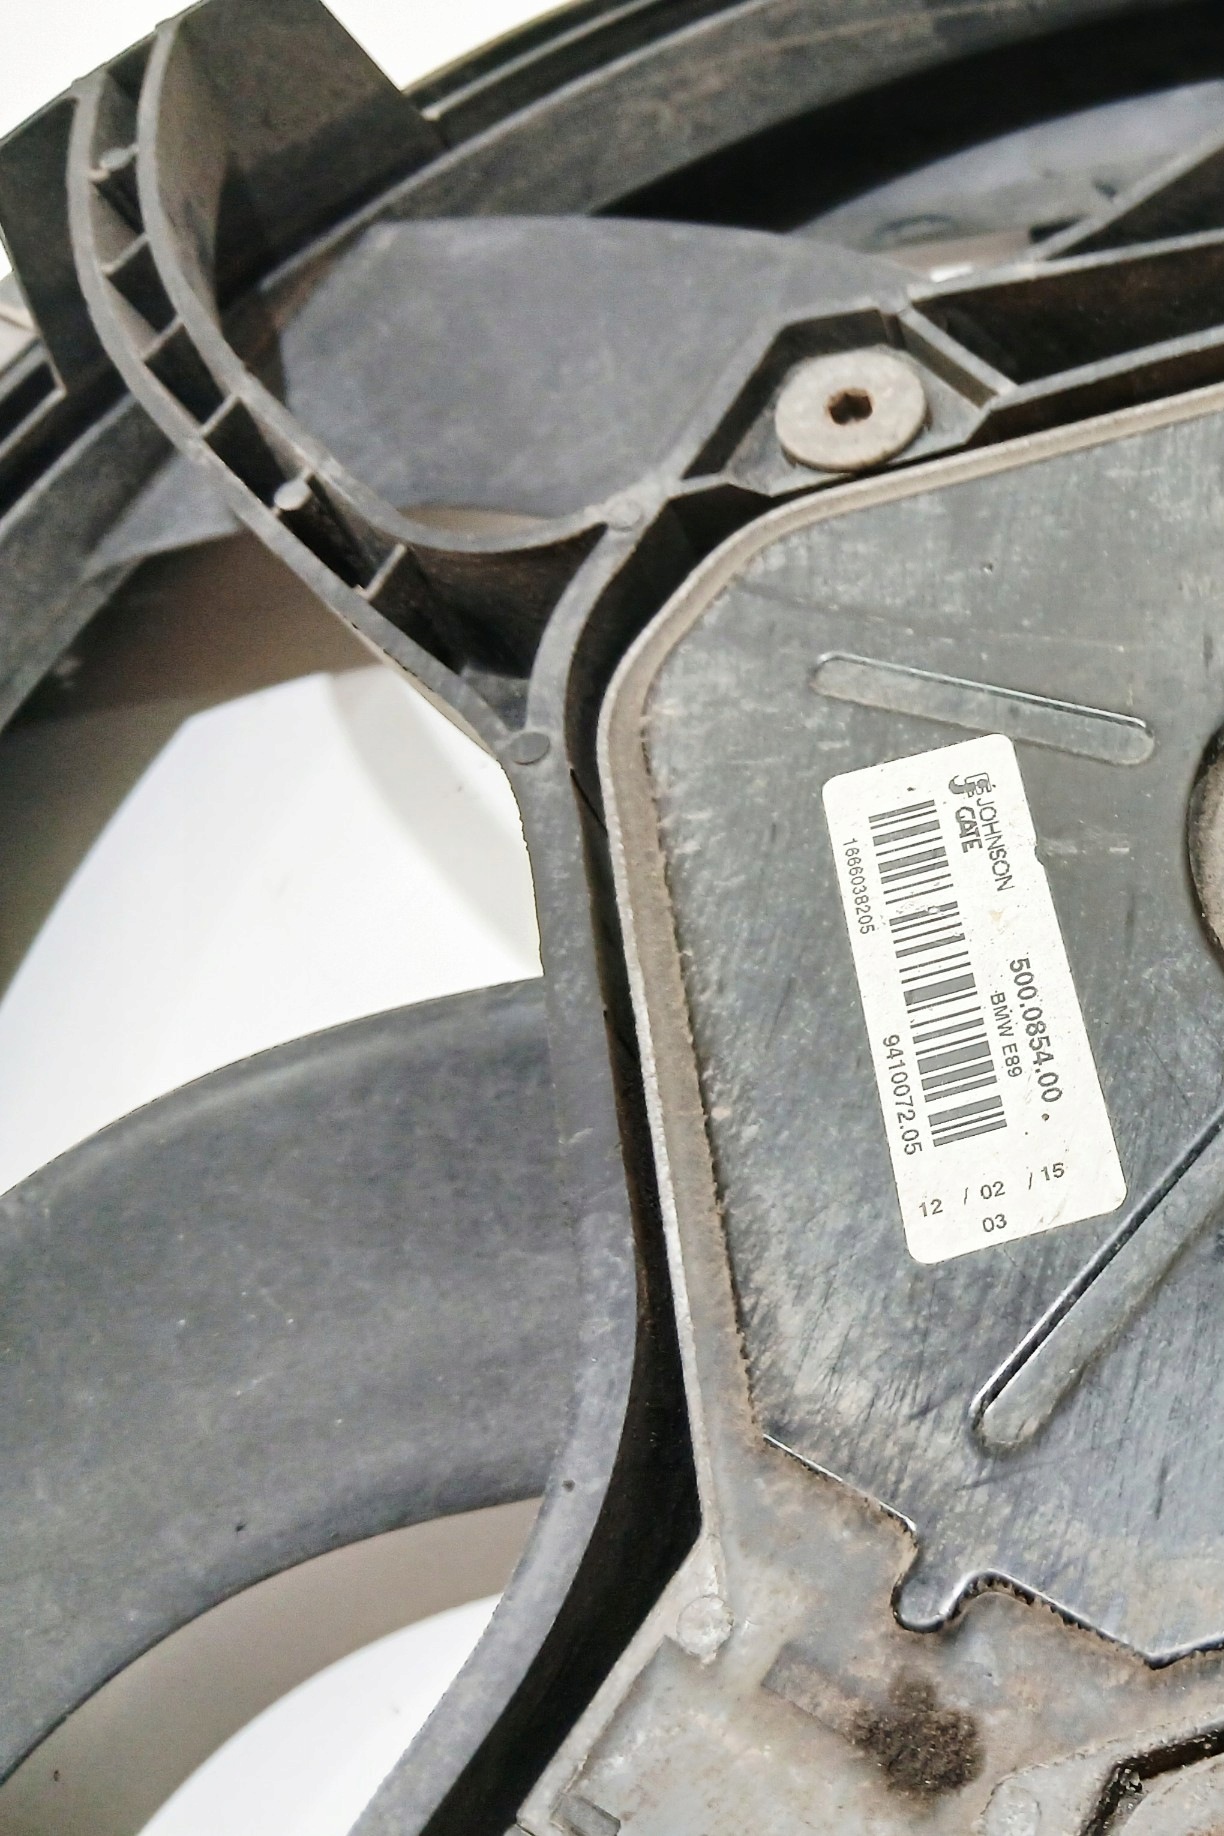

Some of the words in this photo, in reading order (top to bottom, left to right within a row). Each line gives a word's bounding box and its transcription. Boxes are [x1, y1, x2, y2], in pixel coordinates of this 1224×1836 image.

[955, 806, 983, 853] GATE
[977, 798, 1015, 891] JOHNSON
[843, 838, 875, 934] 1666038205
[990, 992, 1015, 1037] BMW
[1010, 957, 1063, 1103] 500.0854.00
[1002, 1043, 1023, 1078] E89
[883, 1035, 922, 1155] 9410072.05
[919, 1199, 943, 1217] 12
[980, 1181, 1006, 1200] 02
[1041, 1162, 1065, 1181] 15
[982, 1214, 1008, 1233] 03
